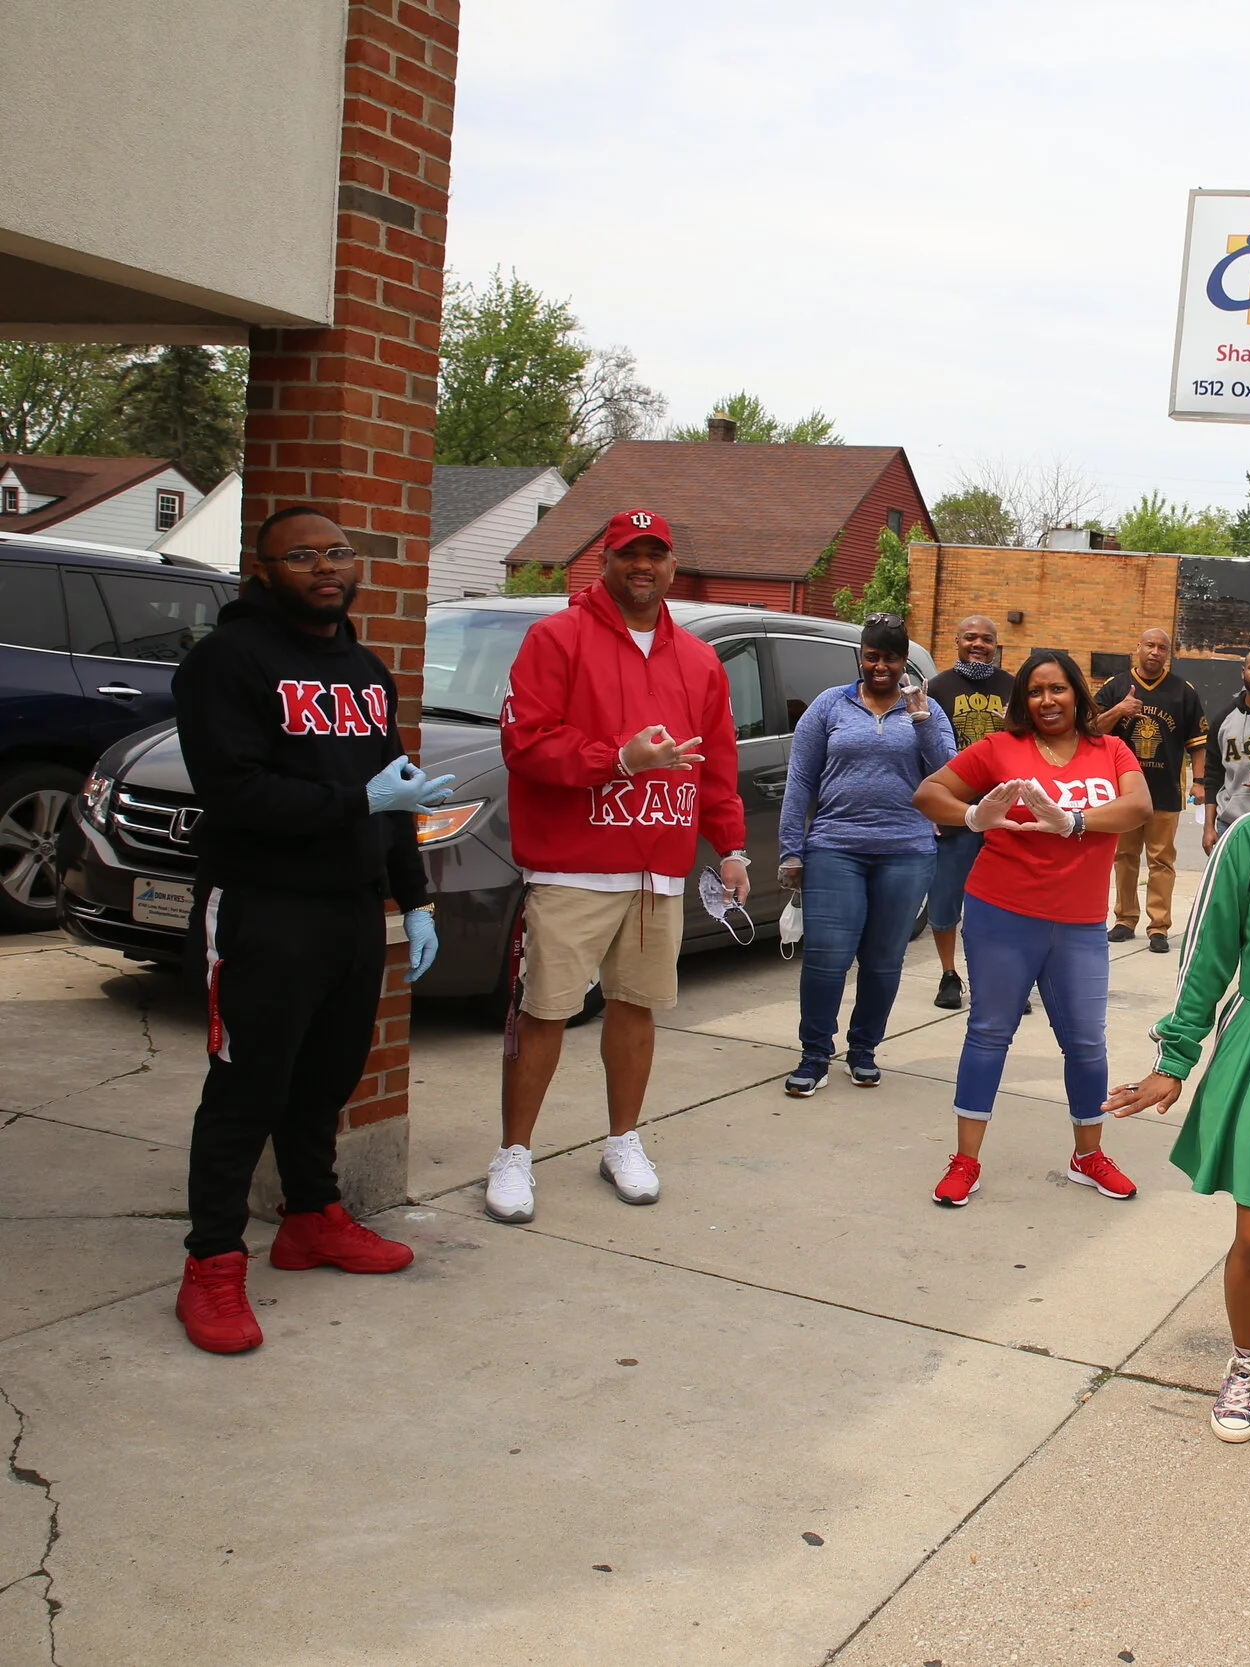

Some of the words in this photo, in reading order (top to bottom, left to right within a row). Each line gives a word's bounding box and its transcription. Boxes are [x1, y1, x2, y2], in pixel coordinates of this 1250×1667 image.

[1192, 380, 1224, 397] 1512
[1143, 705, 1158, 715] PHI
[1157, 710, 1177, 733] ALPHA
